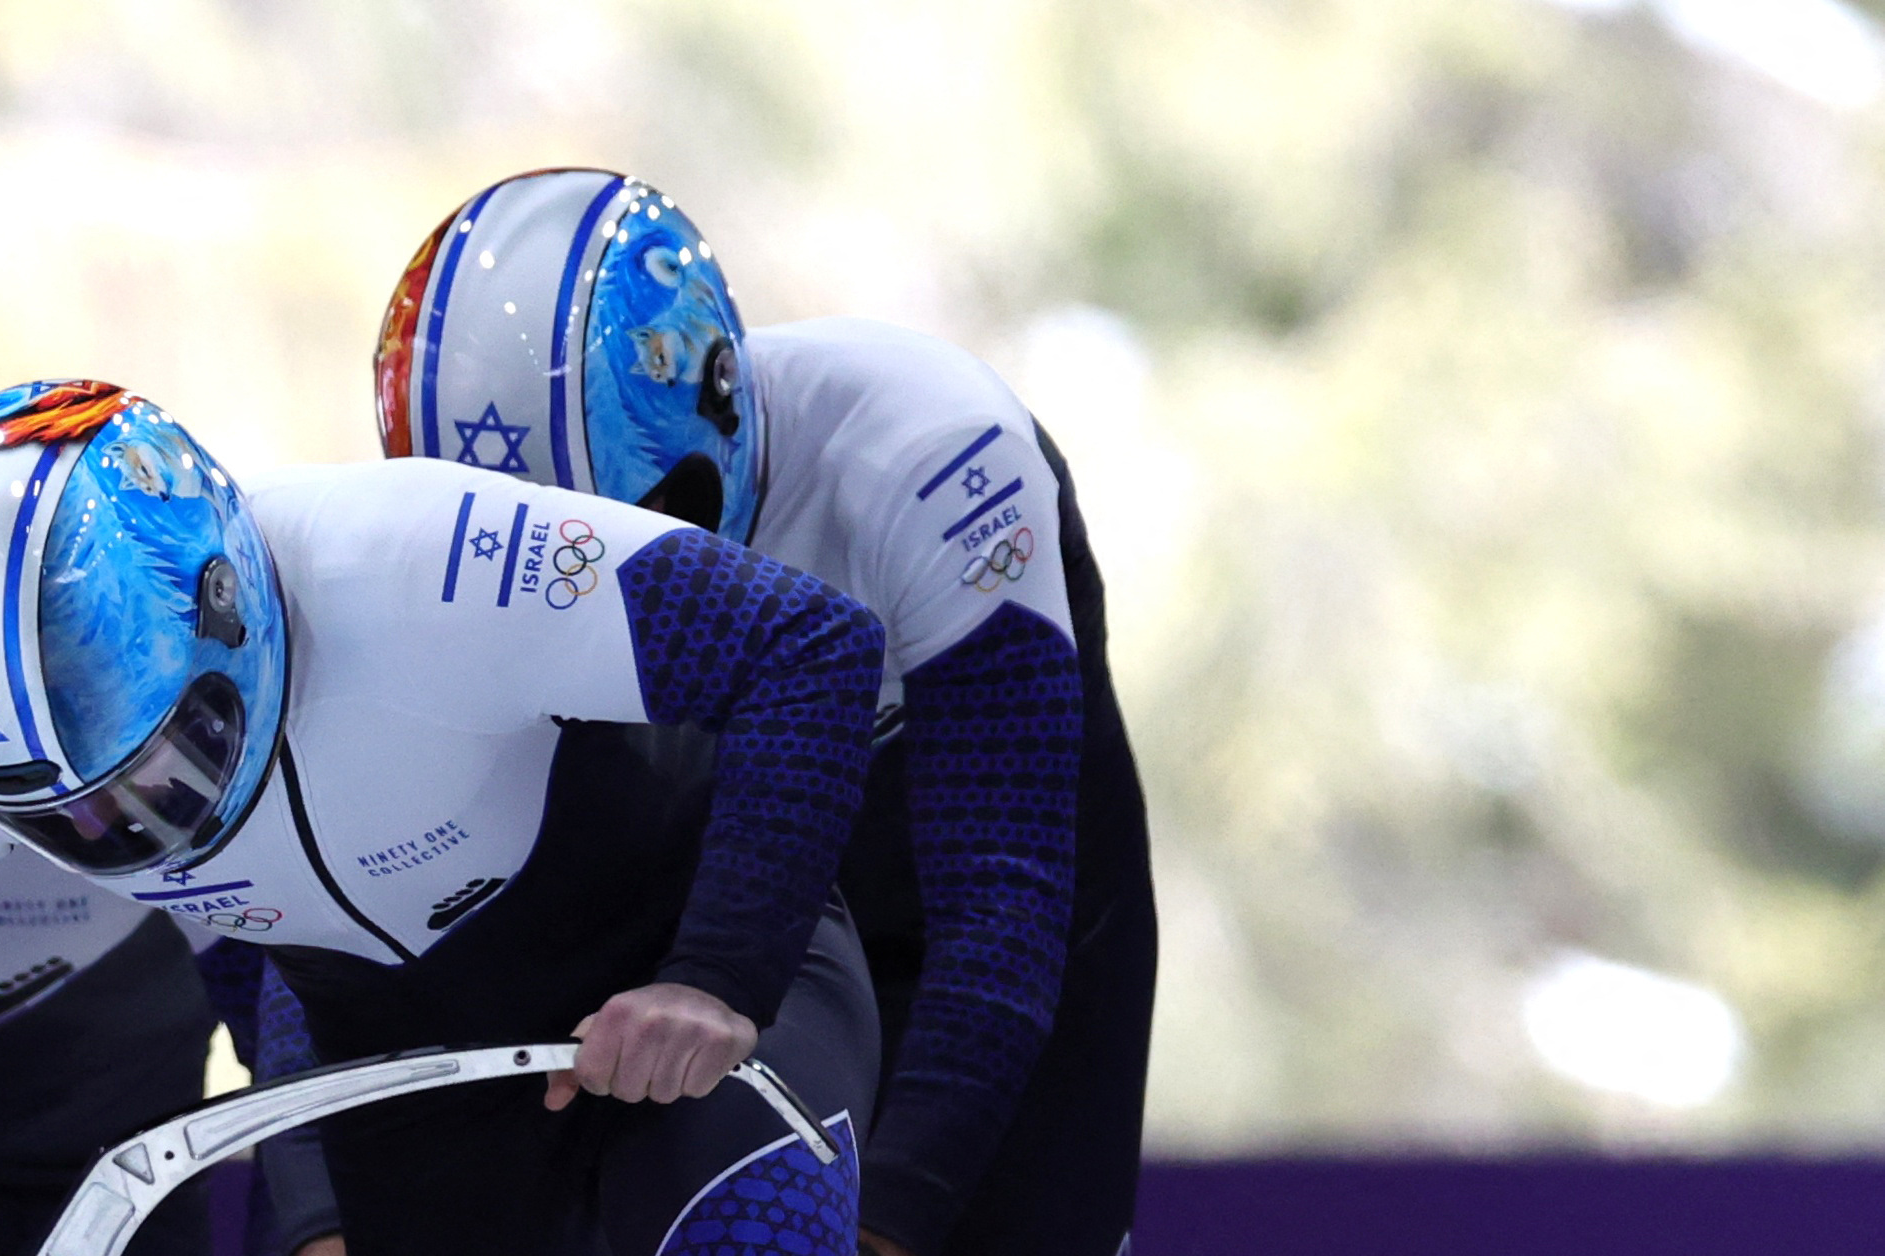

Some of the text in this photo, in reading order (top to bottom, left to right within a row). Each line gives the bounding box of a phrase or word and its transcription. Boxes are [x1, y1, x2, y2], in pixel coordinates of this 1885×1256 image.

[962, 504, 1023, 552] ISRAEL
[520, 521, 550, 593] ISRAEL
[357, 819, 458, 868] NINETY ONE
[368, 829, 471, 877] COLLECTIVE
